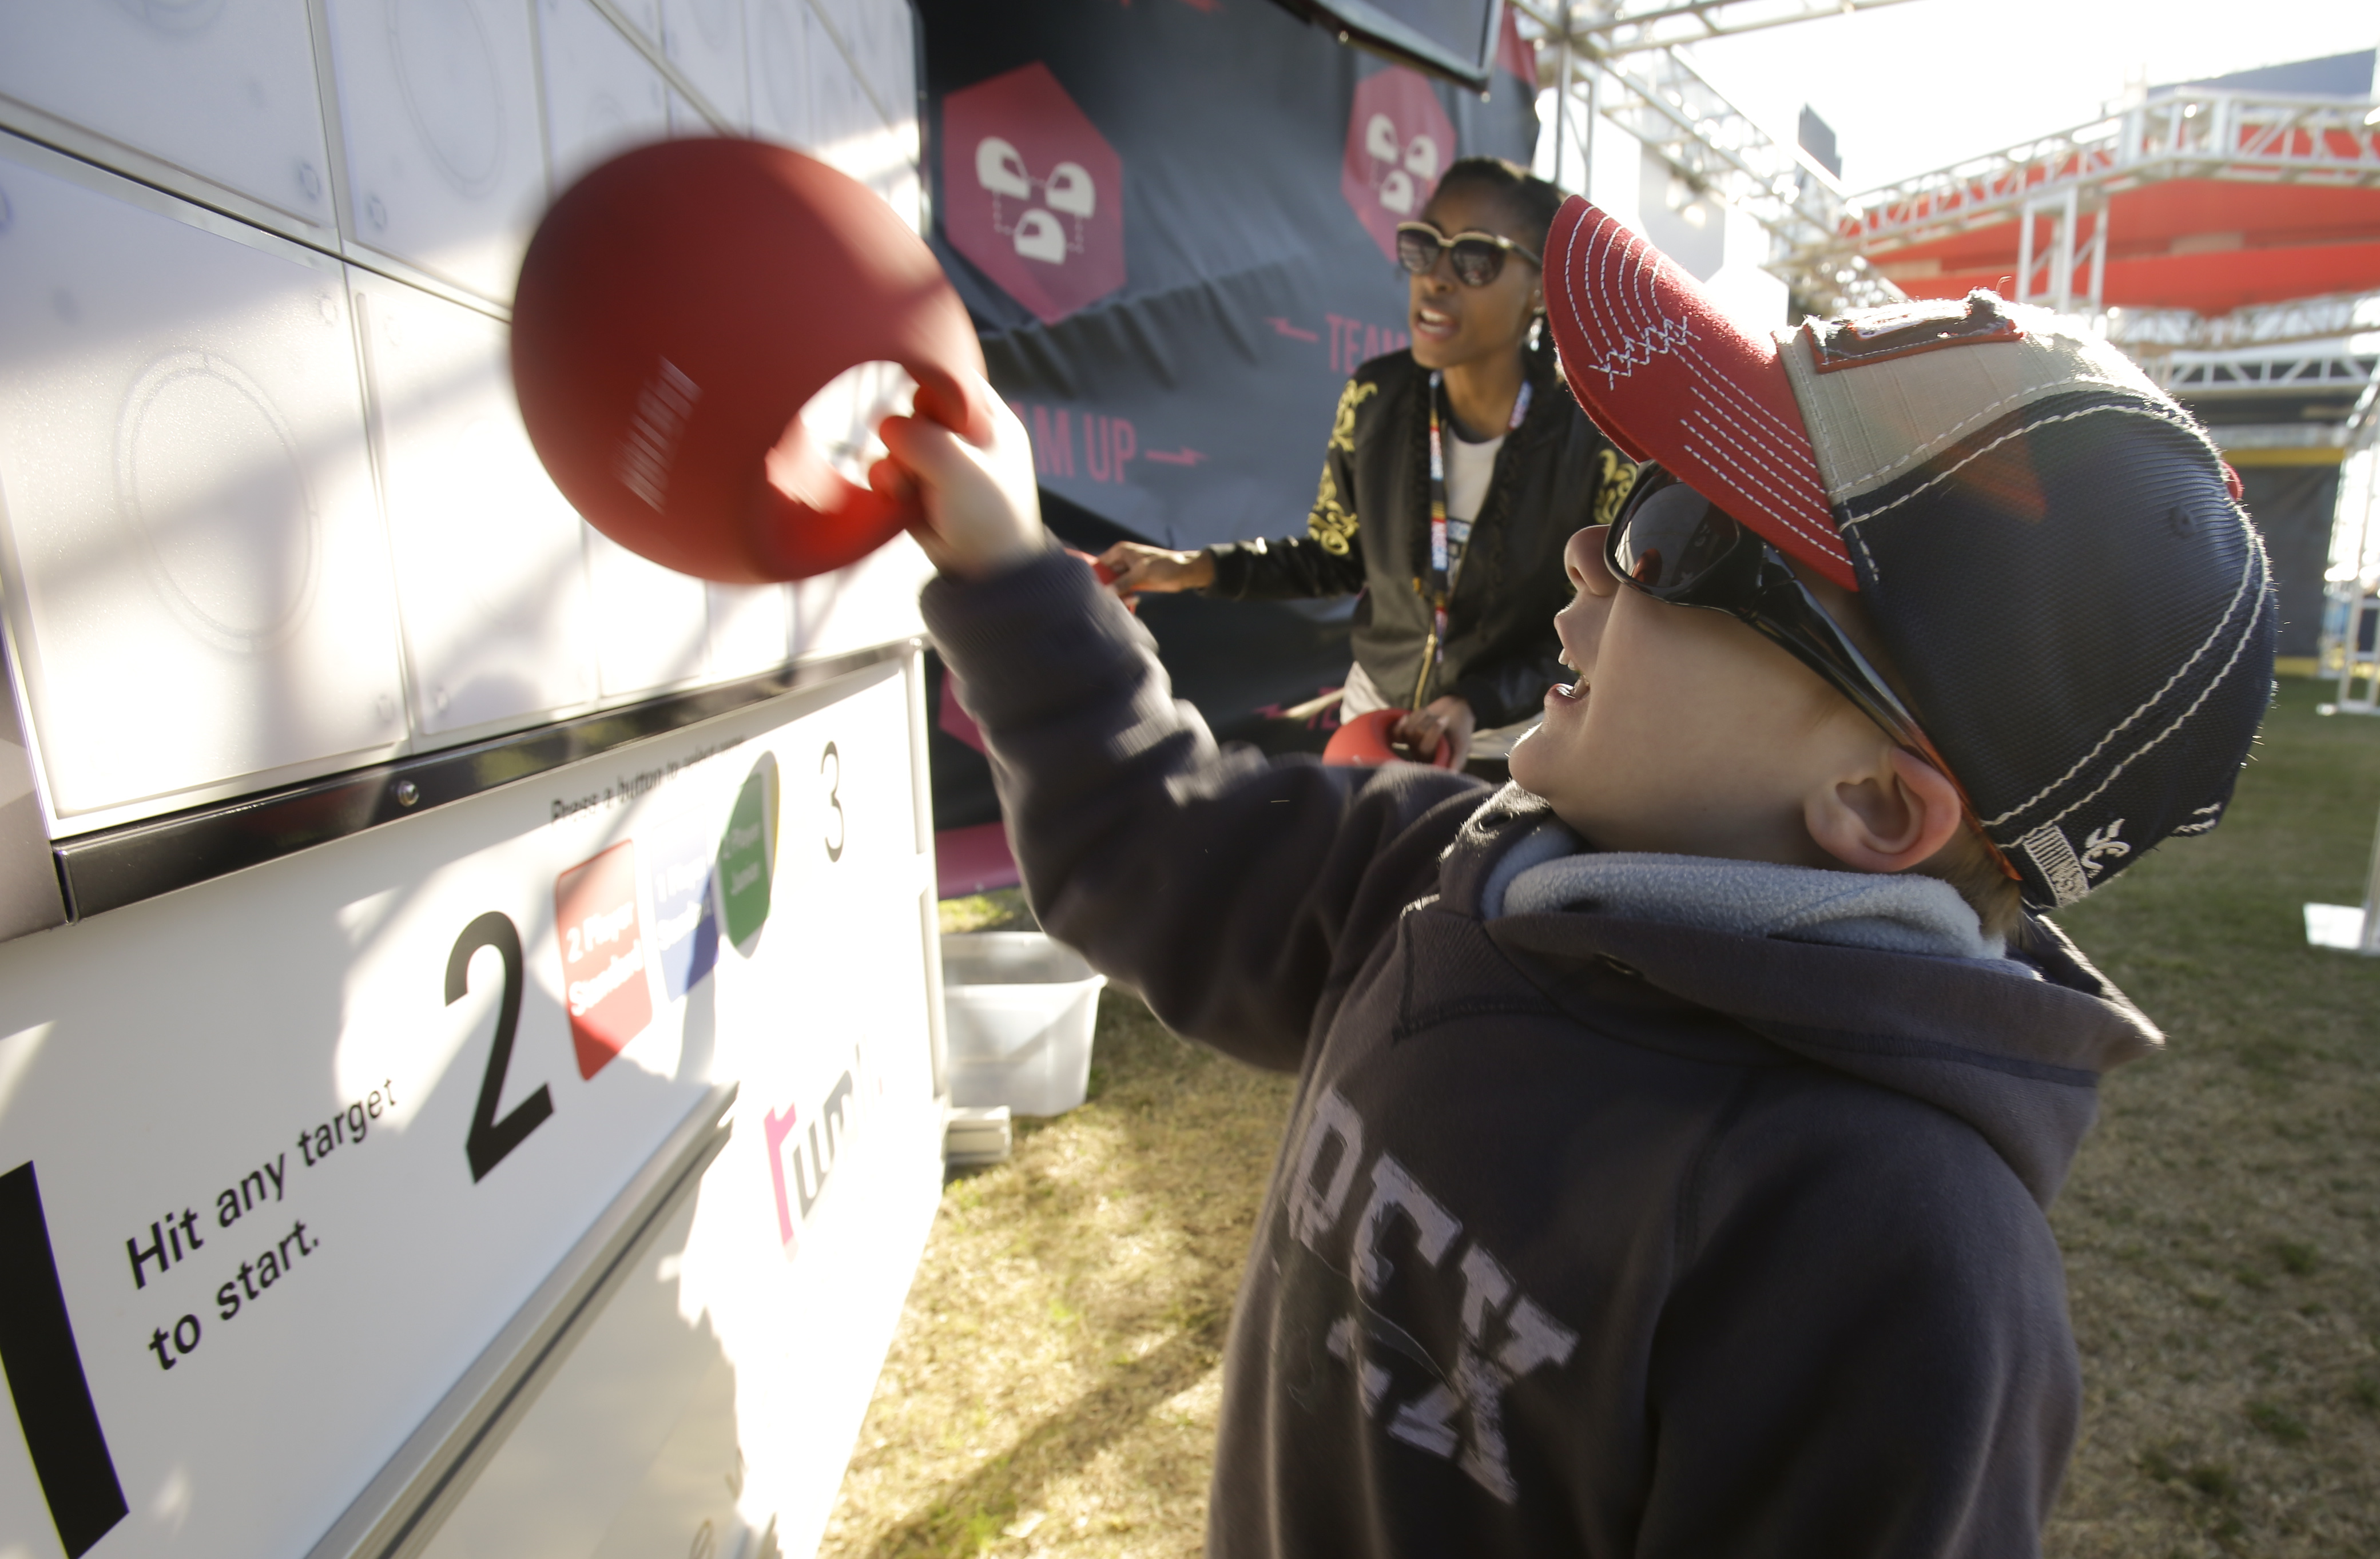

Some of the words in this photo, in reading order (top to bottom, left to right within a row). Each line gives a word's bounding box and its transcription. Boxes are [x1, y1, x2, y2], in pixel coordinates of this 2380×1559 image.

[1083, 412, 1137, 483] UP
[821, 741, 844, 862] 3
[567, 926, 583, 964] 2
[444, 910, 555, 1185] 2
[126, 1207, 205, 1290] Hit
[216, 1152, 285, 1228] any
[297, 1078, 396, 1167] target
[148, 1314, 201, 1370] to
[216, 1219, 320, 1321] start.
